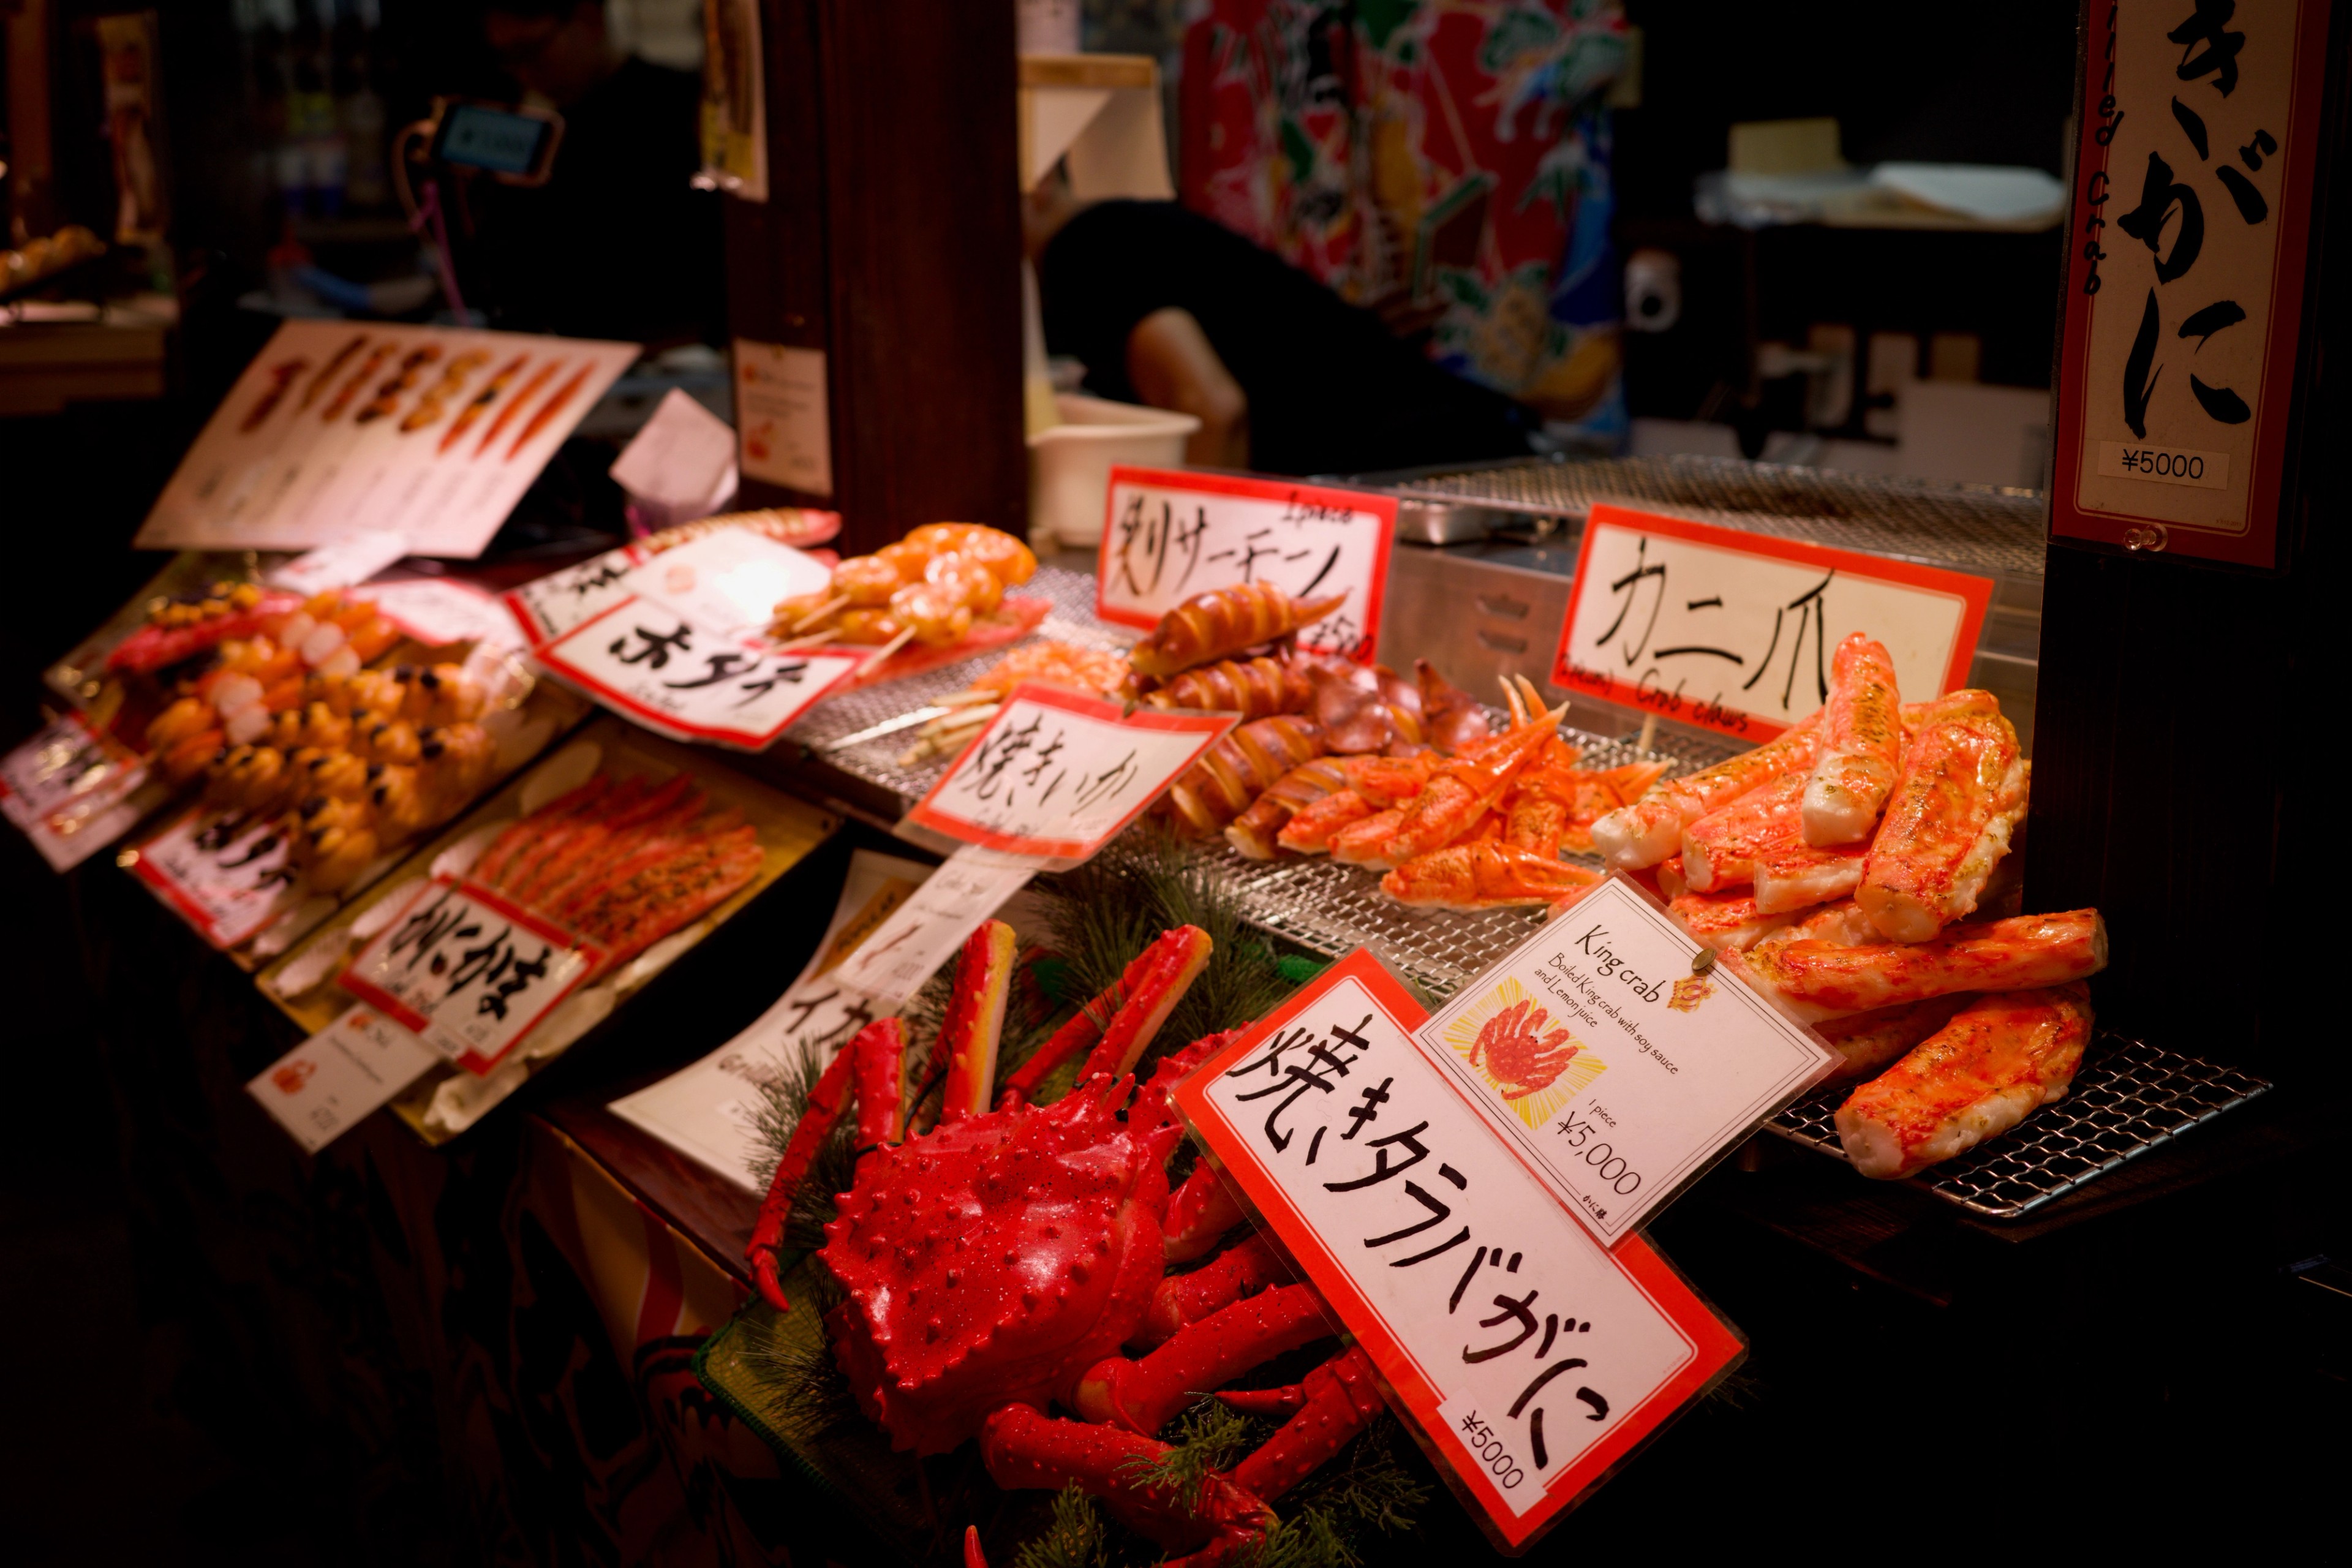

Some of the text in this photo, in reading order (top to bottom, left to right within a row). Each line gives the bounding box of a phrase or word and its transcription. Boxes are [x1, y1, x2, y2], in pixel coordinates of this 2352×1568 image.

[2082, 171, 2110, 295] Crab
[2122, 448, 2204, 481] ¥5000
[1595, 536, 1836, 710] カニ爪
[607, 623, 810, 709] ホタテ
[1636, 668, 1687, 712] Crab
[1692, 691, 1748, 733] claws
[954, 711, 1139, 817] 焼きいか
[1534, 968, 1597, 1028] and Lemon juice
[1574, 924, 1667, 1003] King crab
[1548, 952, 1678, 1074] Boiled King crab with soy sauce
[1557, 1110, 1642, 1195] ¥5,000
[1589, 1106, 1617, 1128] piece
[1225, 1013, 1610, 1470] 焼きタラバがに
[1583, 1194, 1608, 1220] かに勝
[1461, 1409, 1524, 1489] ¥5000
